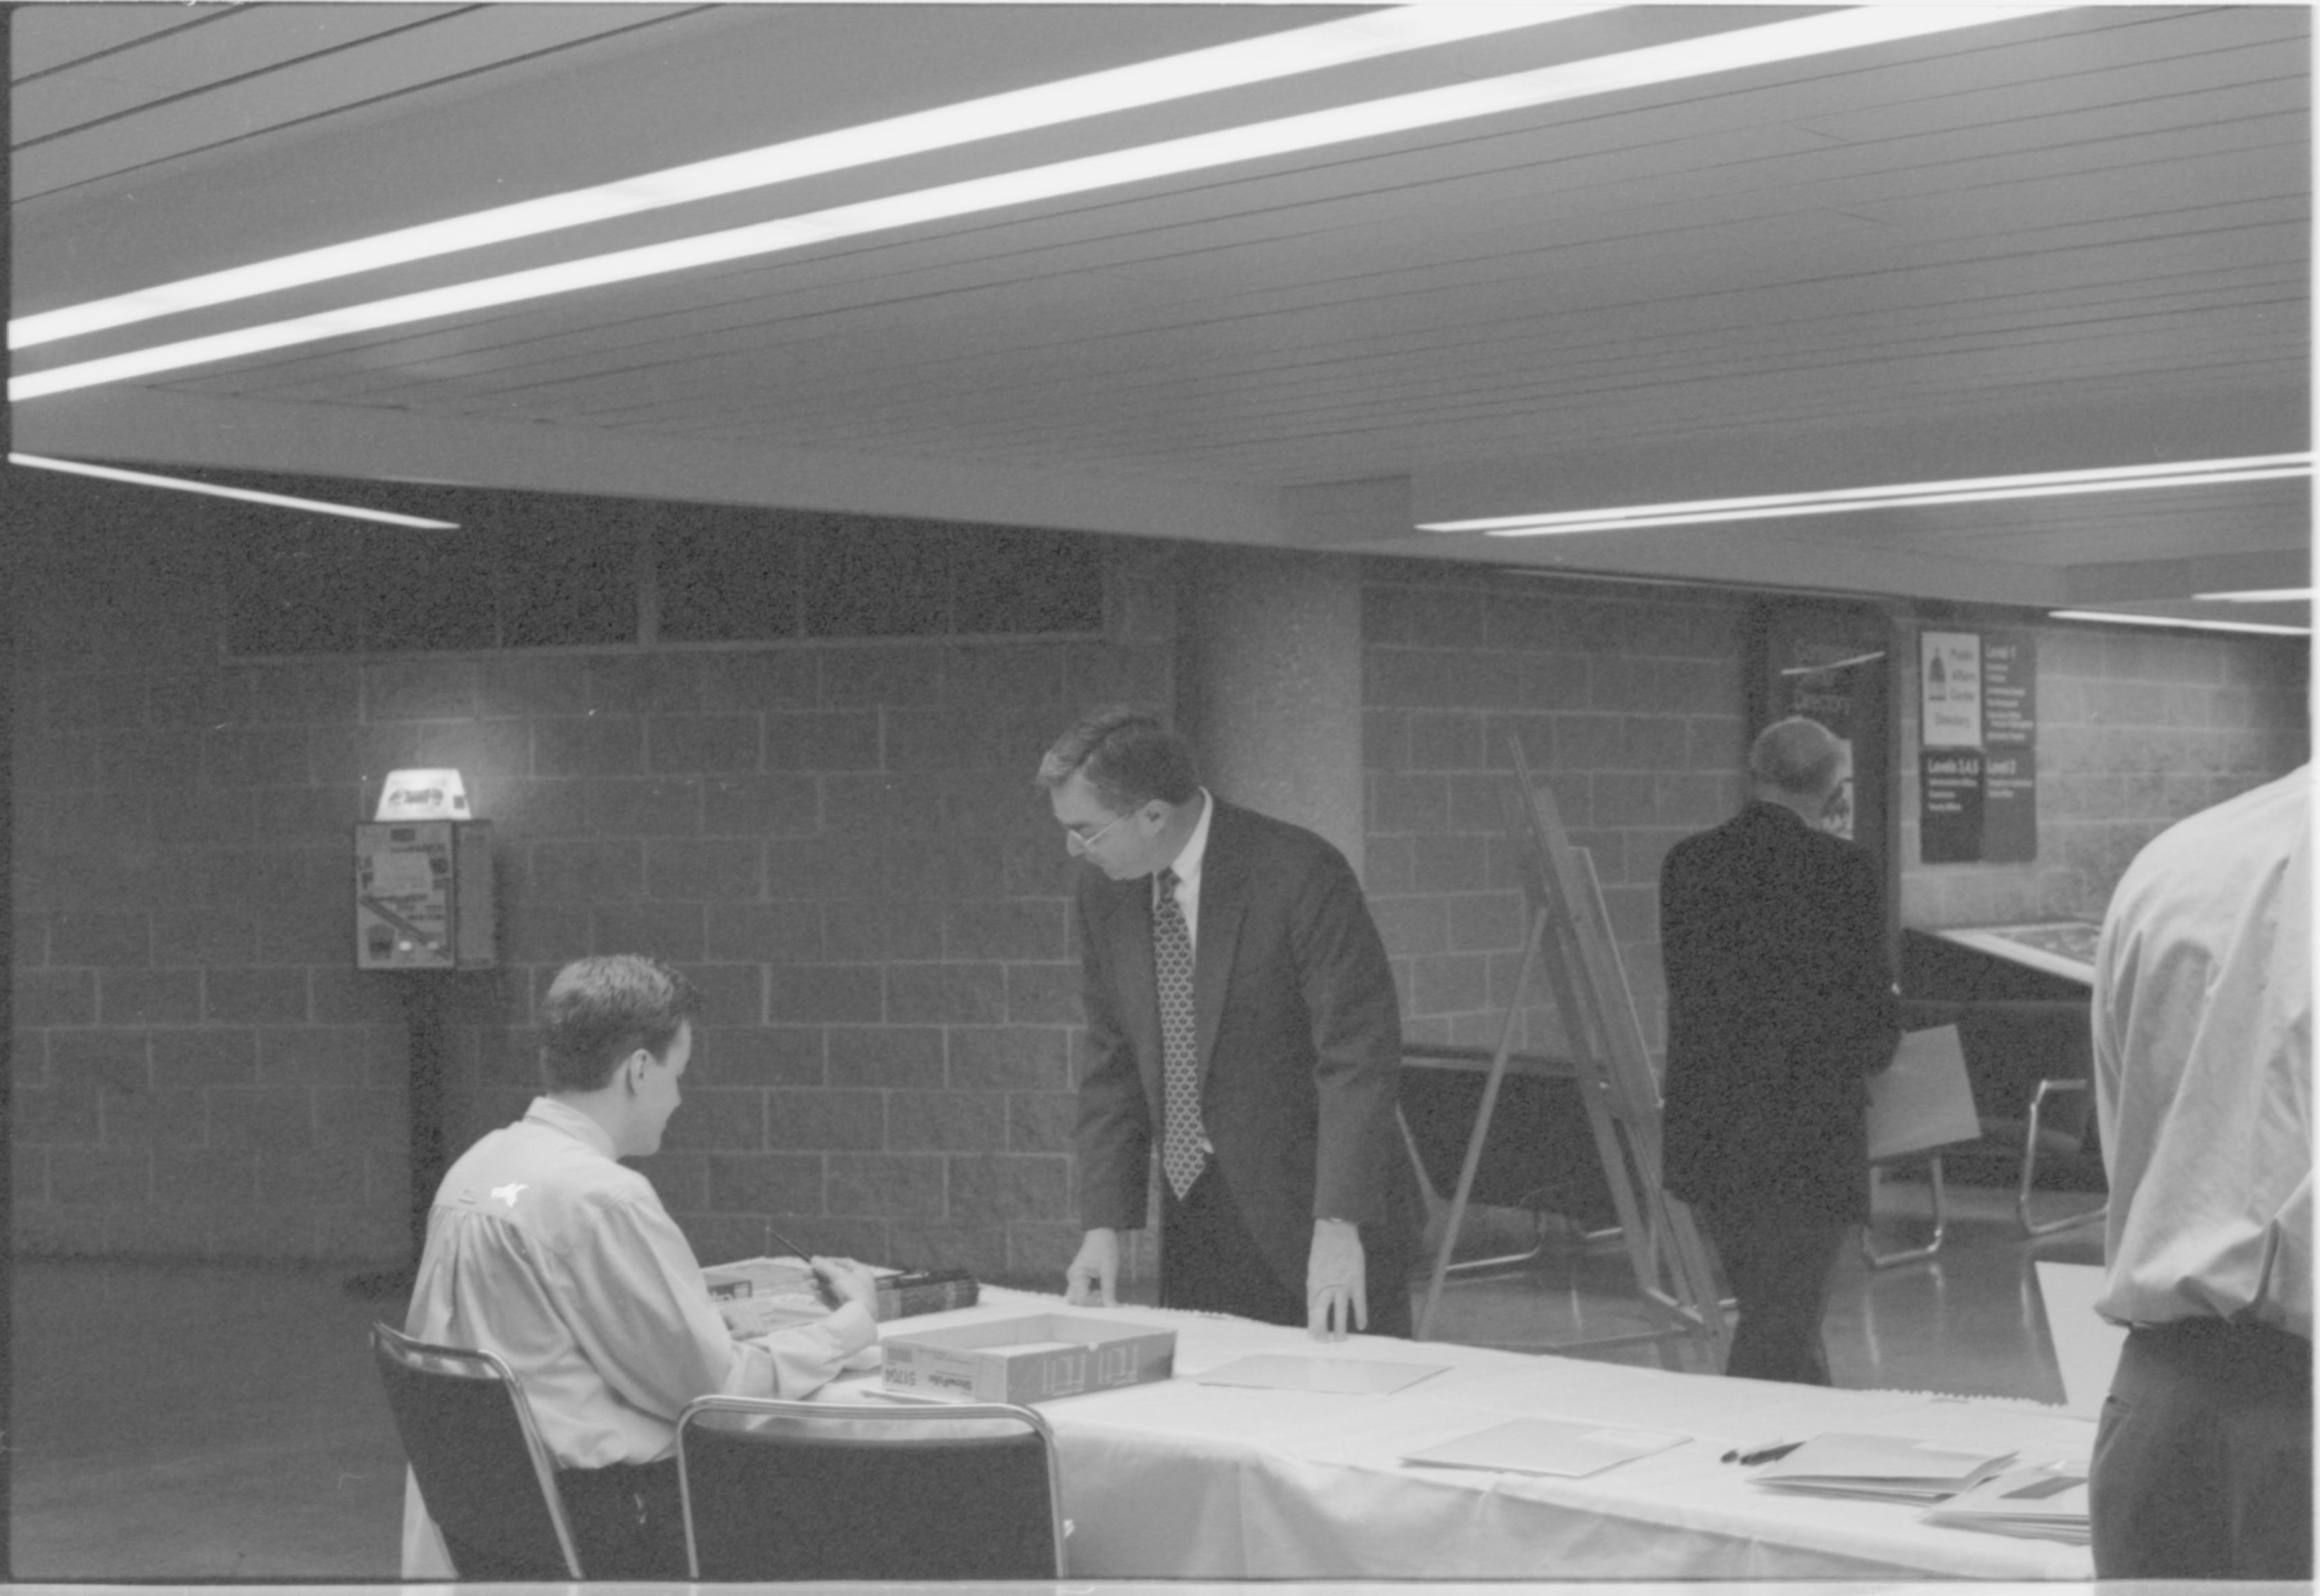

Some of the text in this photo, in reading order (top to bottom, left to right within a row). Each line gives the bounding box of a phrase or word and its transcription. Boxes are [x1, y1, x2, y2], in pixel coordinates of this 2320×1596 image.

[1950, 648, 1974, 662] Public
[1987, 645, 2009, 660] Level
[1935, 712, 1971, 729] Directory
[1929, 758, 1956, 774] Levels
[1987, 758, 2009, 775] Level
